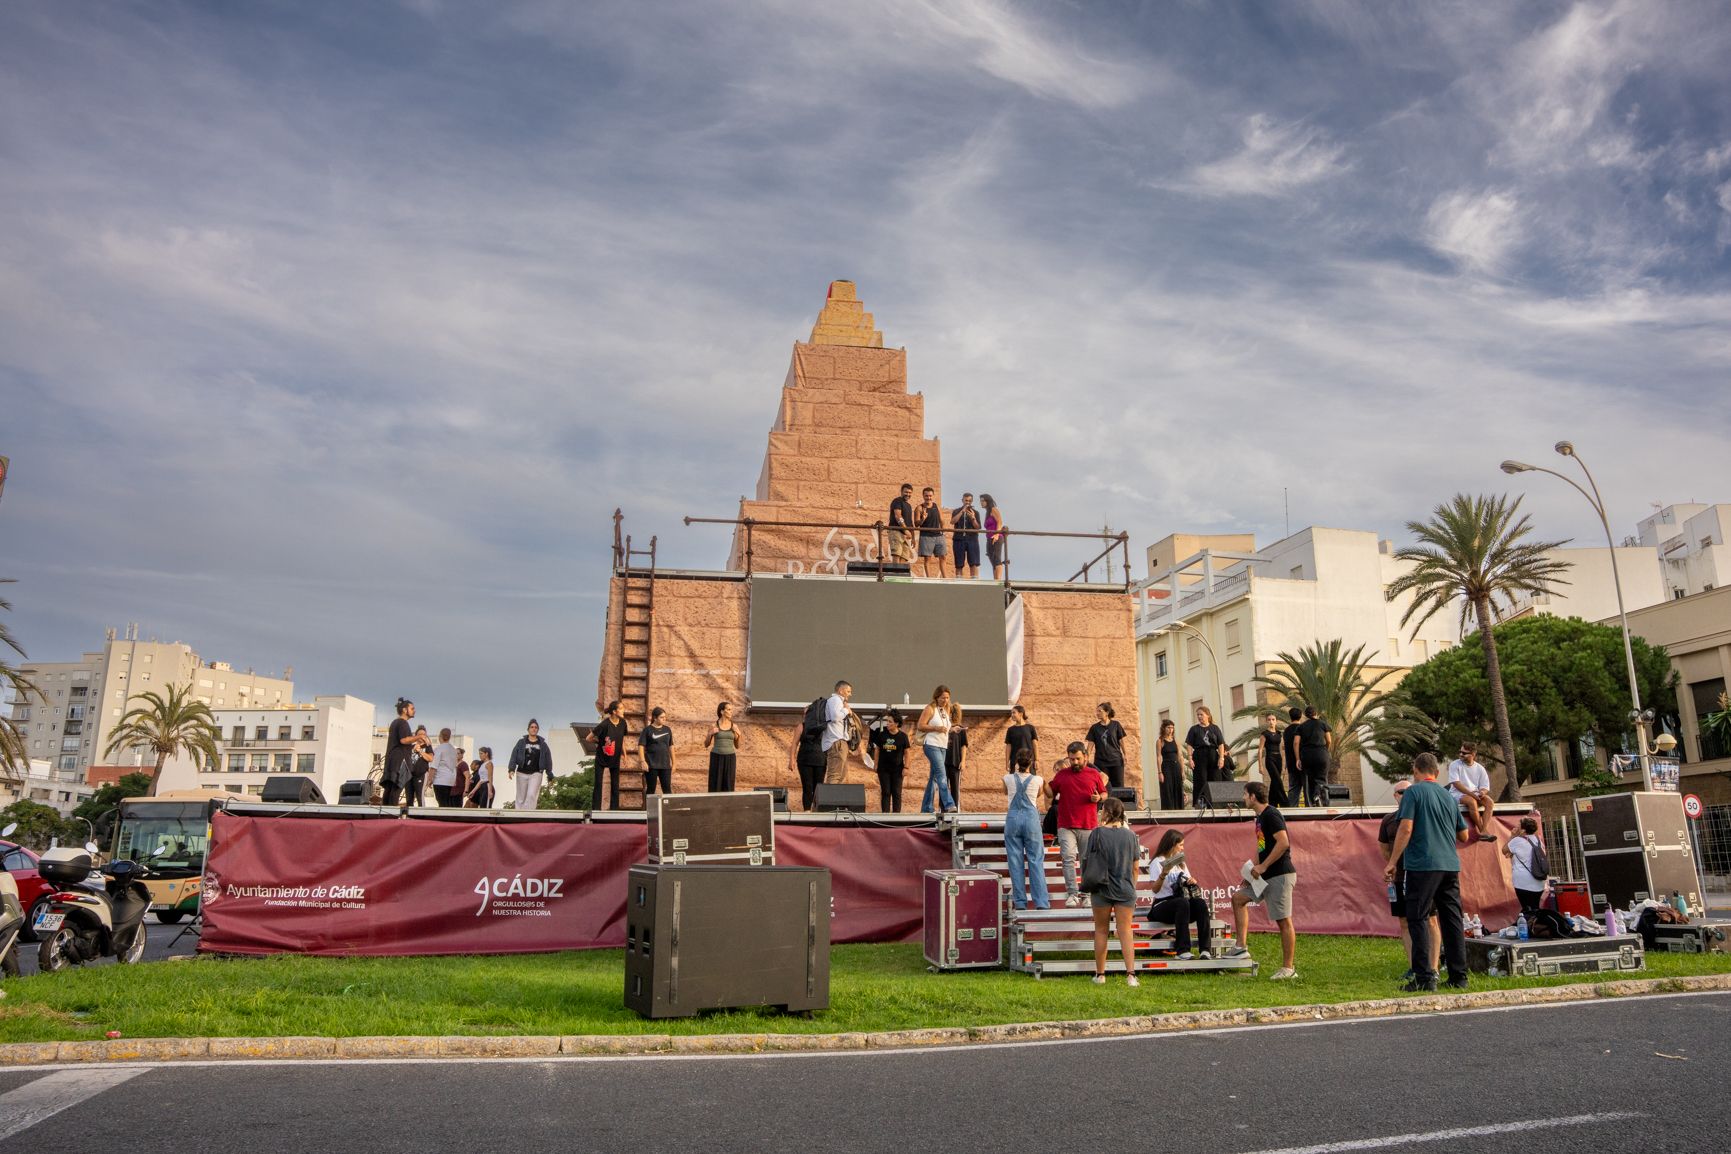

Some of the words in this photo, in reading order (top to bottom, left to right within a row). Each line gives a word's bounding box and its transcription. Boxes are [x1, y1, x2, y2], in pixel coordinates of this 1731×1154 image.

[823, 527, 919, 572] Gads
[1688, 802, 1698, 810] 50
[227, 884, 310, 898] Ayuntamiento
[311, 886, 327, 898] de
[328, 885, 365, 899] Cádiz
[493, 874, 564, 897] CÁDIZ
[1212, 887, 1226, 899] de
[264, 899, 298, 907] Fundación
[298, 900, 331, 908] Municipal
[341, 901, 366, 909] Cultura
